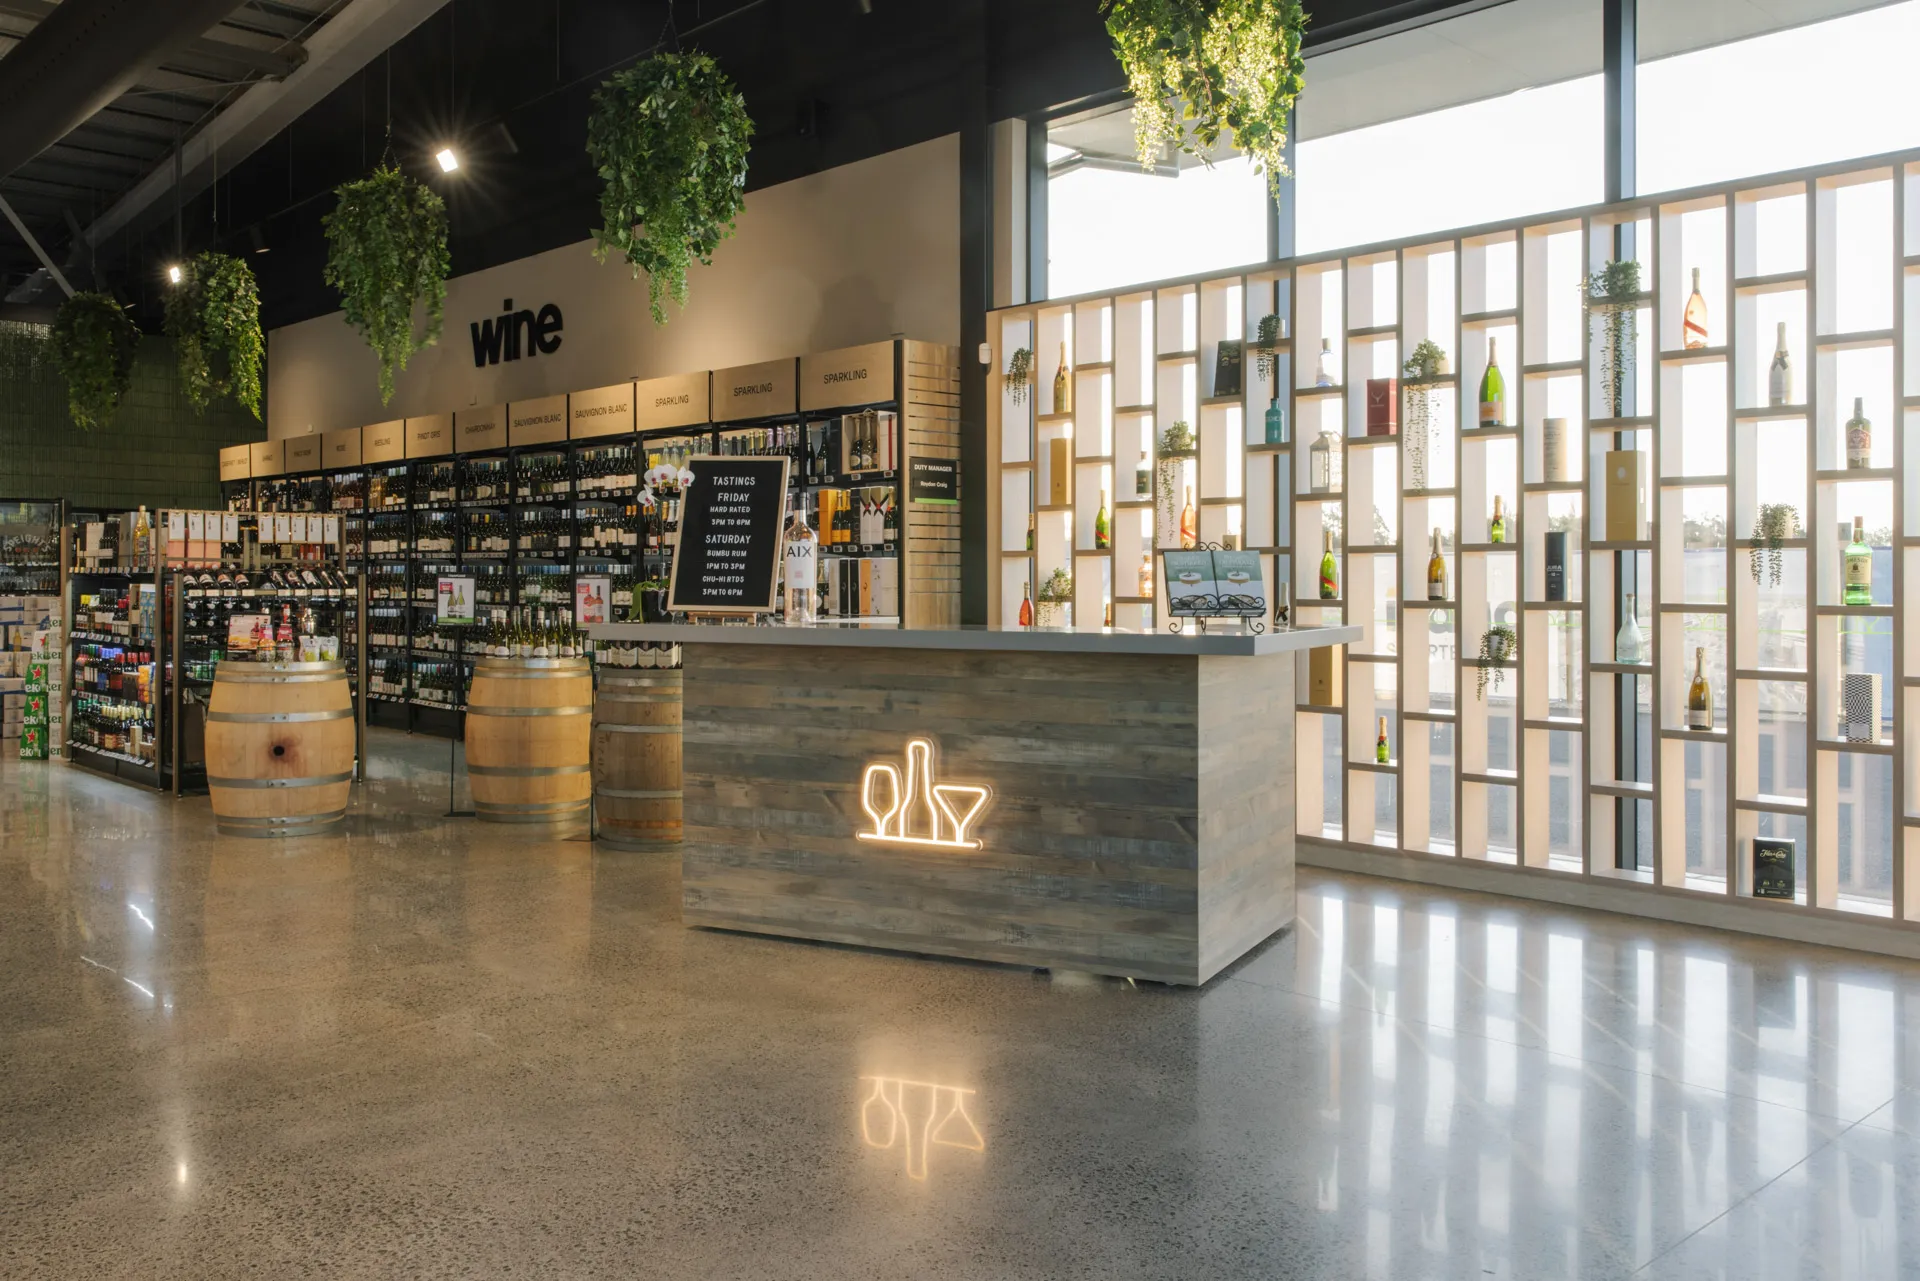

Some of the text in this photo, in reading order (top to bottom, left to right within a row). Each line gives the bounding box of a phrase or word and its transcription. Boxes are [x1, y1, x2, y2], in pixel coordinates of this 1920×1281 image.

[470, 298, 563, 367] wine
[824, 368, 867, 384] SPARKLING
[733, 382, 773, 397] SPARKLING
[655, 394, 689, 408] SPARKLING
[575, 403, 627, 419] SAUVIGNON BLANC
[513, 413, 562, 428] SAUVIGNON BLANC
[928, 465, 953, 473] MANAGER
[713, 476, 756, 486] TASTINGS
[717, 492, 750, 502] FRIDAY
[711, 518, 726, 526] 3PM
[705, 534, 751, 544] SATURDAY
[707, 549, 730, 557] BUMBU
[786, 545, 812, 558] AIX
[706, 562, 720, 570] 1PM
[702, 575, 726, 583] CHU-HI
[702, 588, 743, 596] 3PM TO 6PM
